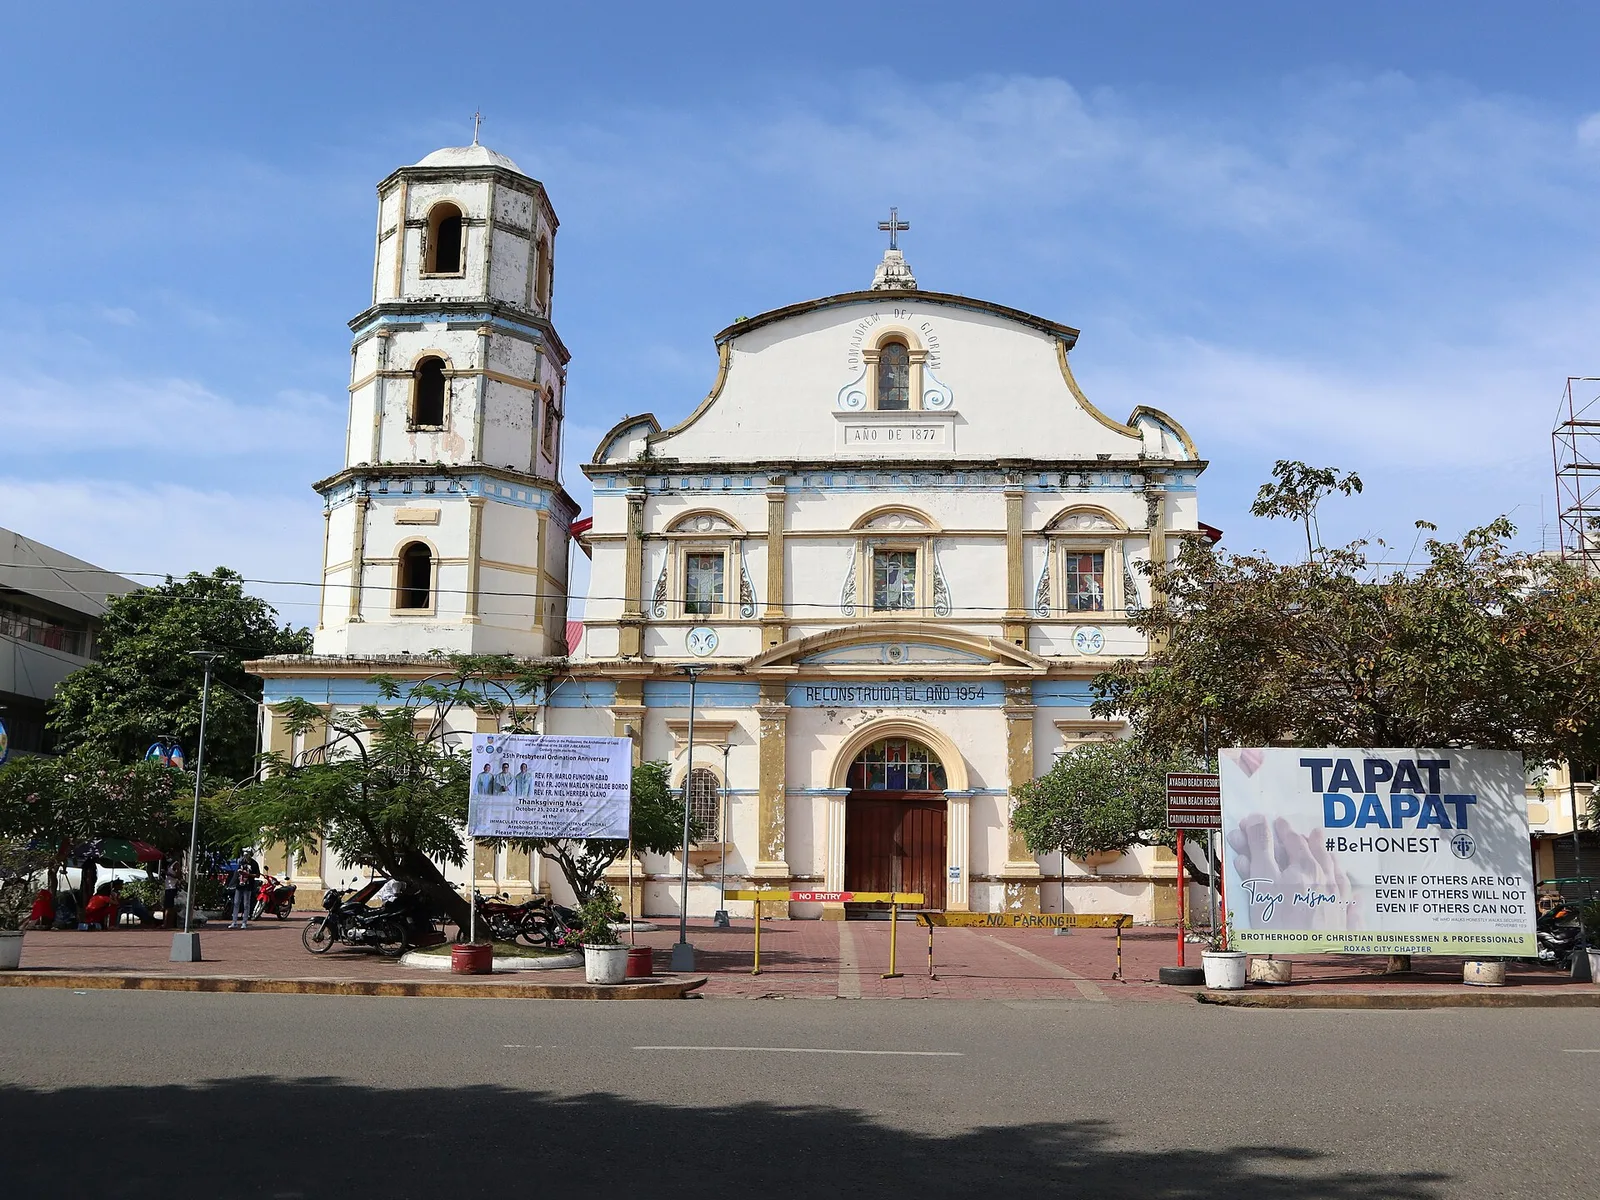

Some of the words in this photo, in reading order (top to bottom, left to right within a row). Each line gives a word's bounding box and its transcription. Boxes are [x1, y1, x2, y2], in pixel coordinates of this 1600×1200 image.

[894, 308, 914, 321] DEI
[920, 321, 941, 370] GLORIAM
[854, 427, 877, 440] AÑO
[888, 429, 902, 440] DE
[911, 429, 936, 440] 1877
[806, 686, 900, 701] RECONSTRUIDA
[905, 686, 922, 701] EL
[926, 684, 950, 701] AÑO
[955, 686, 985, 701] 1954
[516, 753, 547, 761] Presbyteral
[577, 755, 610, 763] Anniversary
[1300, 758, 1450, 794] TAPAT
[1188, 778, 1203, 787] BEACH
[518, 798, 564, 807] Thanksgiving
[1188, 796, 1203, 806] BEACH
[1204, 797, 1220, 806] RESOR
[1322, 793, 1477, 830] DAPAT
[1196, 815, 1209, 824] RIVER
[1325, 836, 1440, 854] #BeHONEST
[1374, 875, 1405, 885] EVEN
[1408, 875, 1418, 885] IF
[1421, 875, 1468, 886] OTHERS
[1471, 876, 1494, 886] ARE
[1497, 876, 1522, 886] NOT
[1241, 878, 1284, 922] Tayo
[1375, 889, 1406, 899] EVEN
[1408, 889, 1418, 899] IF
[1421, 889, 1469, 900] OTHERS
[1472, 890, 1499, 900] WILL
[1502, 890, 1527, 900] NOT
[1376, 903, 1406, 913] EVEN
[1409, 903, 1419, 913] IF
[1422, 903, 1470, 914] OTHERS
[1473, 904, 1497, 914] CAN
[1500, 904, 1526, 915] NOT.
[1240, 933, 1309, 941] BROTHERHOOD
[1326, 934, 1374, 942] CHRISTIAN
[1376, 935, 1440, 943] BUSINESSMEN
[1451, 936, 1525, 944] PROFESSIONALS
